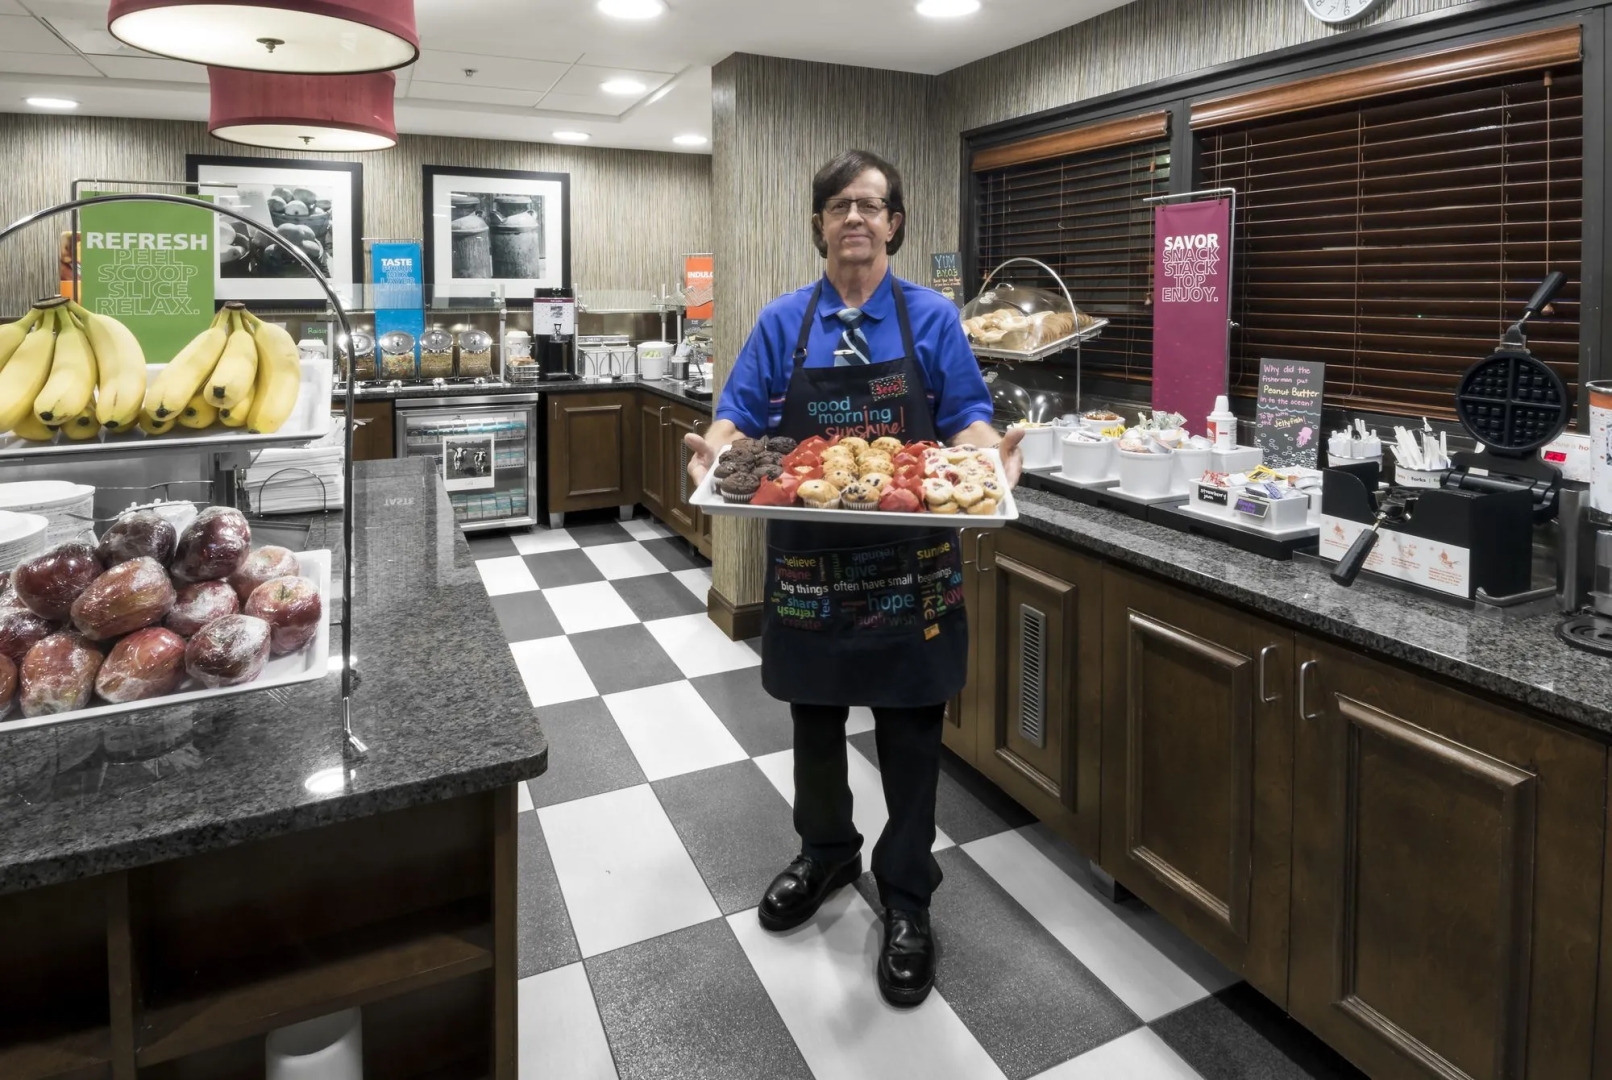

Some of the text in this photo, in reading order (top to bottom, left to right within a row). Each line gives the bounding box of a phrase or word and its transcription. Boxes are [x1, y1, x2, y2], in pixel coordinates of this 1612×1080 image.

[1327, 5, 1336, 15] 7
[1344, 6, 1350, 16] 6
[86, 231, 208, 250] REFRESH
[1165, 233, 1218, 250] SAVOR
[113, 248, 183, 266] PEEL
[381, 258, 413, 266] TASTE
[935, 255, 955, 268] YUM
[1163, 246, 1220, 263] SNACK
[97, 264, 199, 282] SCOOP
[1165, 261, 1217, 276] STACK
[1174, 274, 1205, 288] TOP
[108, 281, 189, 299] SLICE
[1162, 287, 1218, 302] ENJOY.
[95, 297, 201, 316] RELAX.
[1264, 365, 1310, 376] Why did the
[1264, 385, 1319, 398] Peanut Butter
[807, 396, 851, 416] good
[818, 405, 892, 424] morning
[825, 406, 905, 438] sunshine!
[783, 554, 817, 568] believe
[845, 564, 878, 582] give
[780, 580, 795, 594] big
[796, 583, 829, 596] things
[833, 580, 860, 592] often
[861, 578, 886, 591] have
[887, 573, 913, 586] small
[787, 595, 819, 609] share
[867, 590, 915, 614] hope
[920, 583, 937, 621] like
[942, 586, 963, 606] lov
[776, 605, 816, 620] refresh
